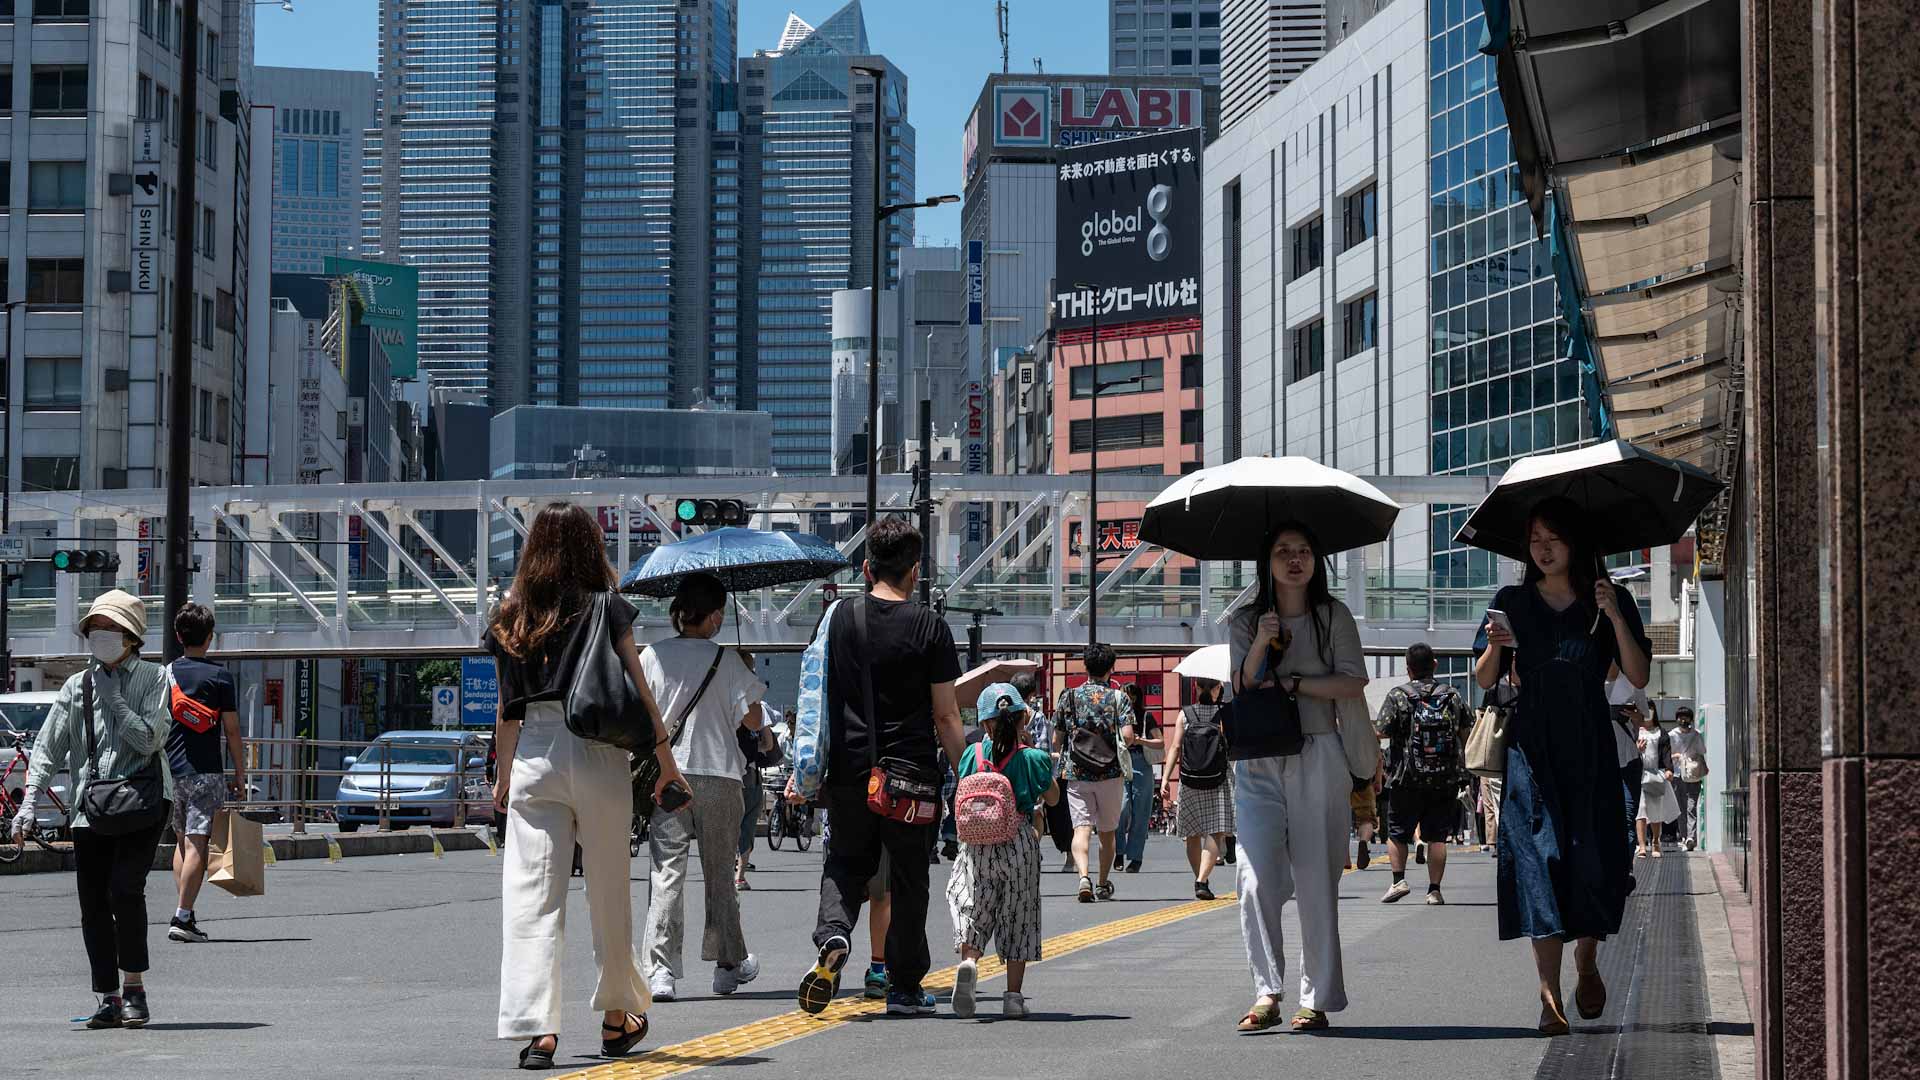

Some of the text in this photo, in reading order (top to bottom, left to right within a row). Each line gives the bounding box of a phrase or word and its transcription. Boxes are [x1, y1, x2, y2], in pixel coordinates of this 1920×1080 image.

[1060, 87, 1200, 127] LABI
[1060, 147, 1196, 181] 未来の不動産を面白くする。
[139, 209, 151, 289] SHINJUKU
[1081, 206, 1141, 256] global
[1107, 237, 1121, 245] Global
[973, 277, 982, 303] LABI
[1057, 277, 1198, 319] THEグローバル社
[378, 304, 404, 317] Security
[969, 395, 981, 436] LABI
[464, 691, 498, 699] Sendagaya
